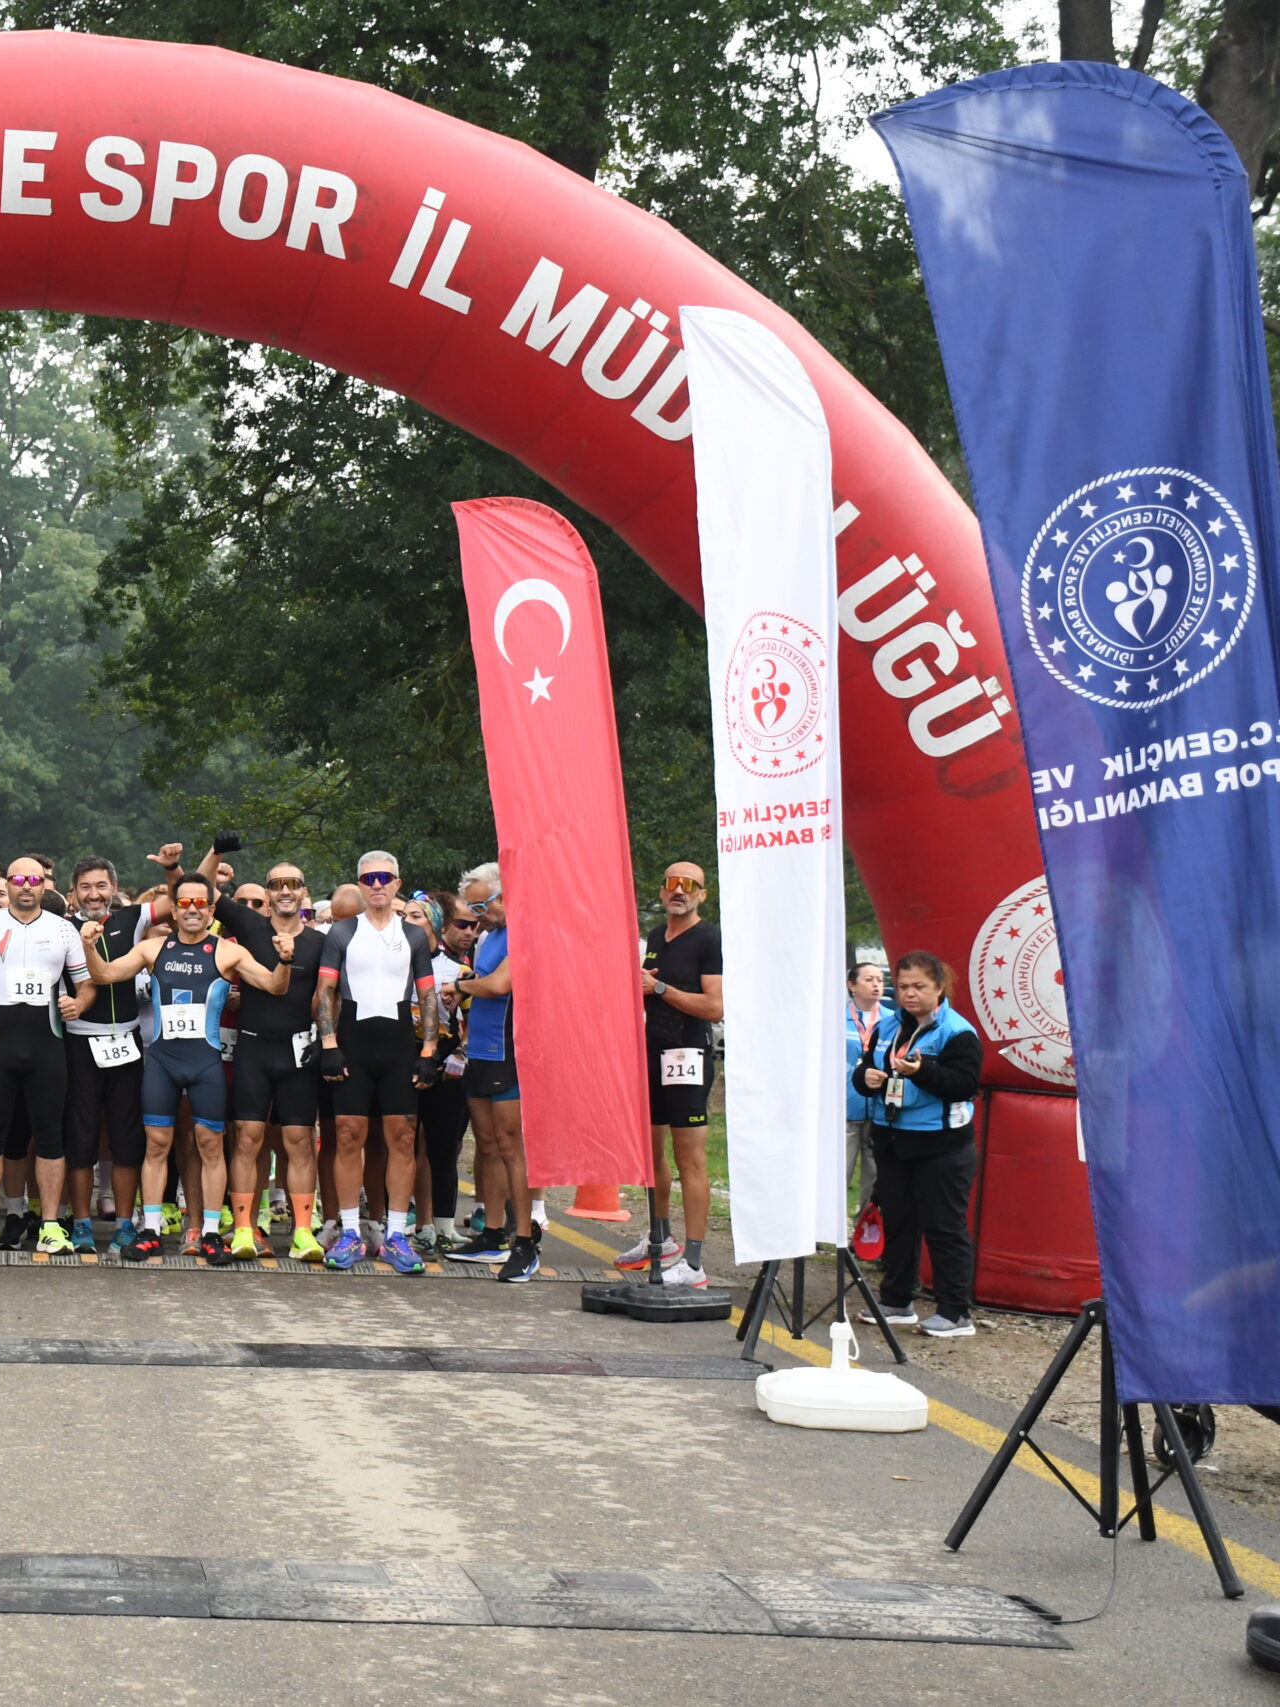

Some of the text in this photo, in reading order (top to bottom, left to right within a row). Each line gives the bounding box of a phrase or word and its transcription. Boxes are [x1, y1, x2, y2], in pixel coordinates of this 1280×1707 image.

[80, 135, 357, 260] SPOR
[389, 186, 472, 315] İL
[165, 961, 203, 975] GÜMÜŞ 55
[15, 983, 44, 995] 181
[168, 1019, 197, 1033] 191
[1030, 1009, 1070, 1044] RKİYE
[102, 1046, 130, 1061] 185
[667, 1064, 697, 1078] 214
